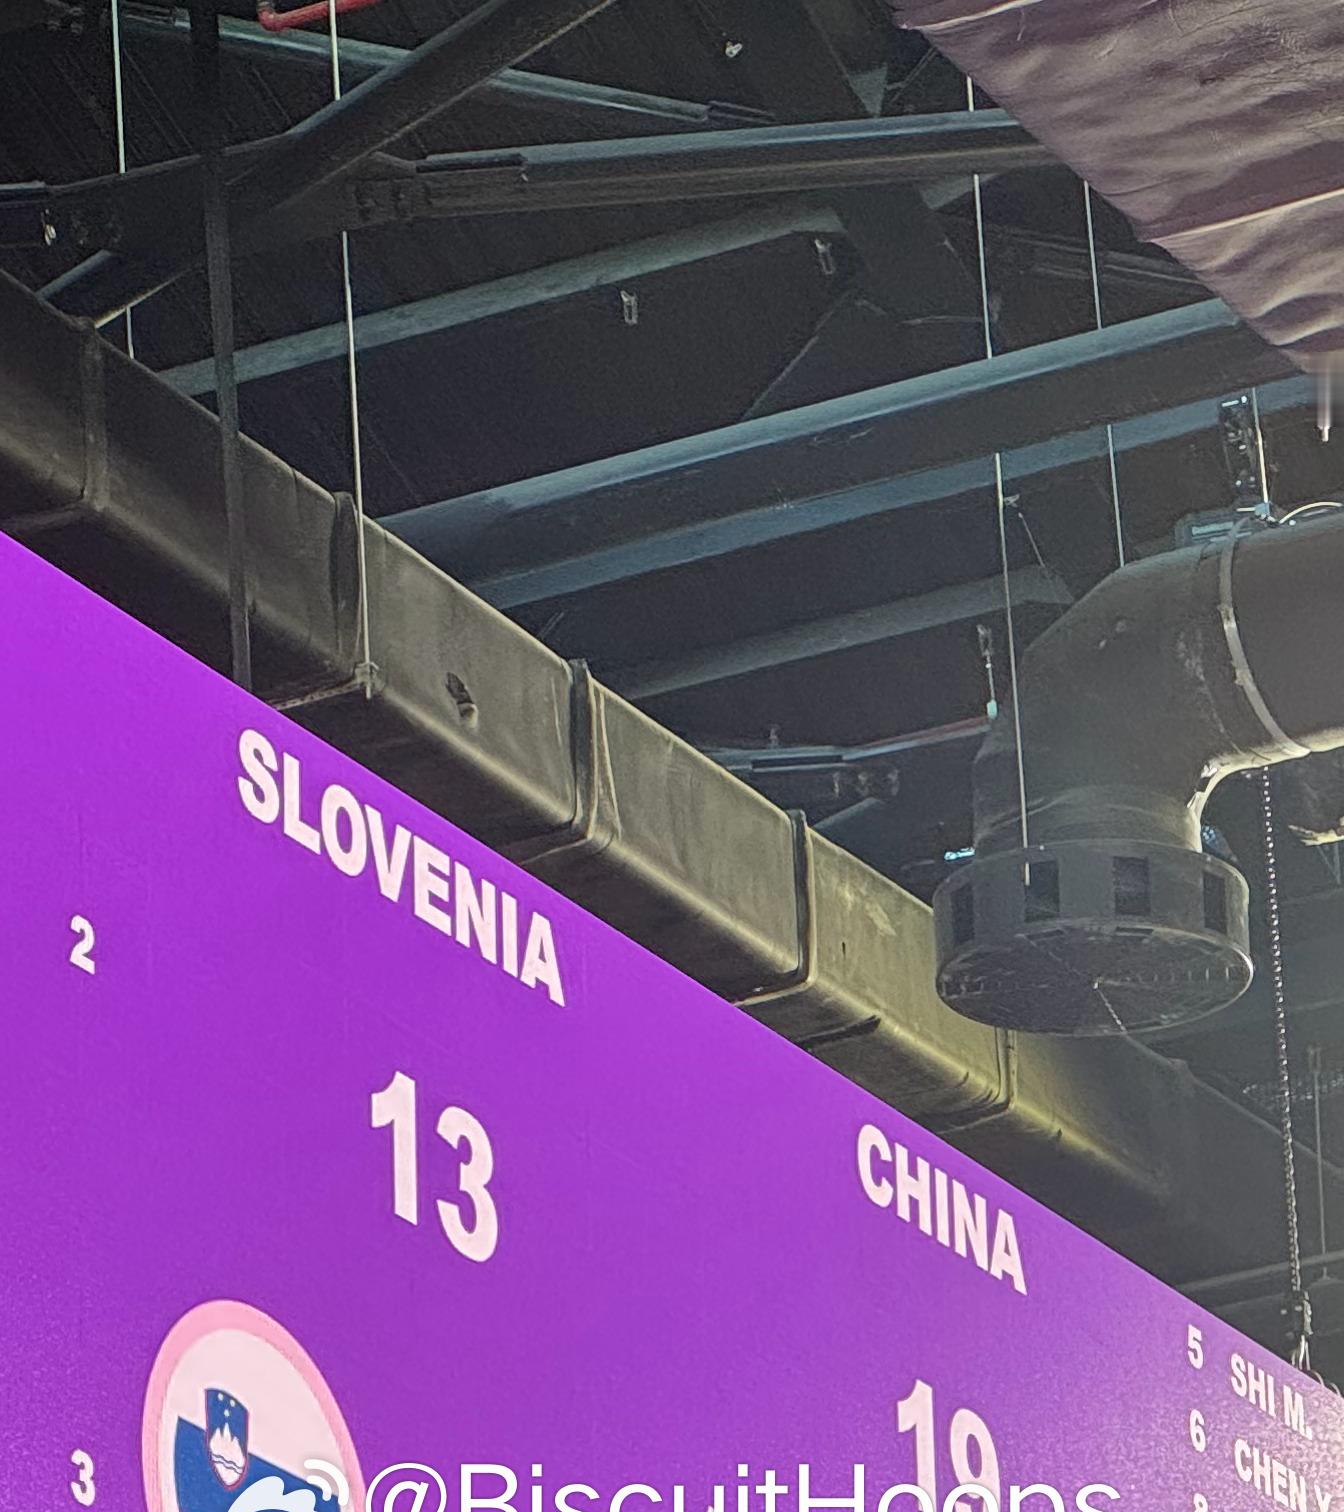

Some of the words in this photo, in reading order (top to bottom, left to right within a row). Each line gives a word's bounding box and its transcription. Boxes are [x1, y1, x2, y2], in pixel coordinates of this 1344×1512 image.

[236, 729, 565, 1007] SLOVENIA
[71, 915, 95, 975] 2
[370, 1069, 498, 1263] 13
[857, 1123, 1027, 1295] CHINA
[1188, 1324, 1204, 1369] 5
[1231, 1353, 1276, 1418] SHI
[1284, 1384, 1312, 1441] M.
[1189, 1409, 1206, 1453] 6
[72, 1449, 95, 1507] 3
